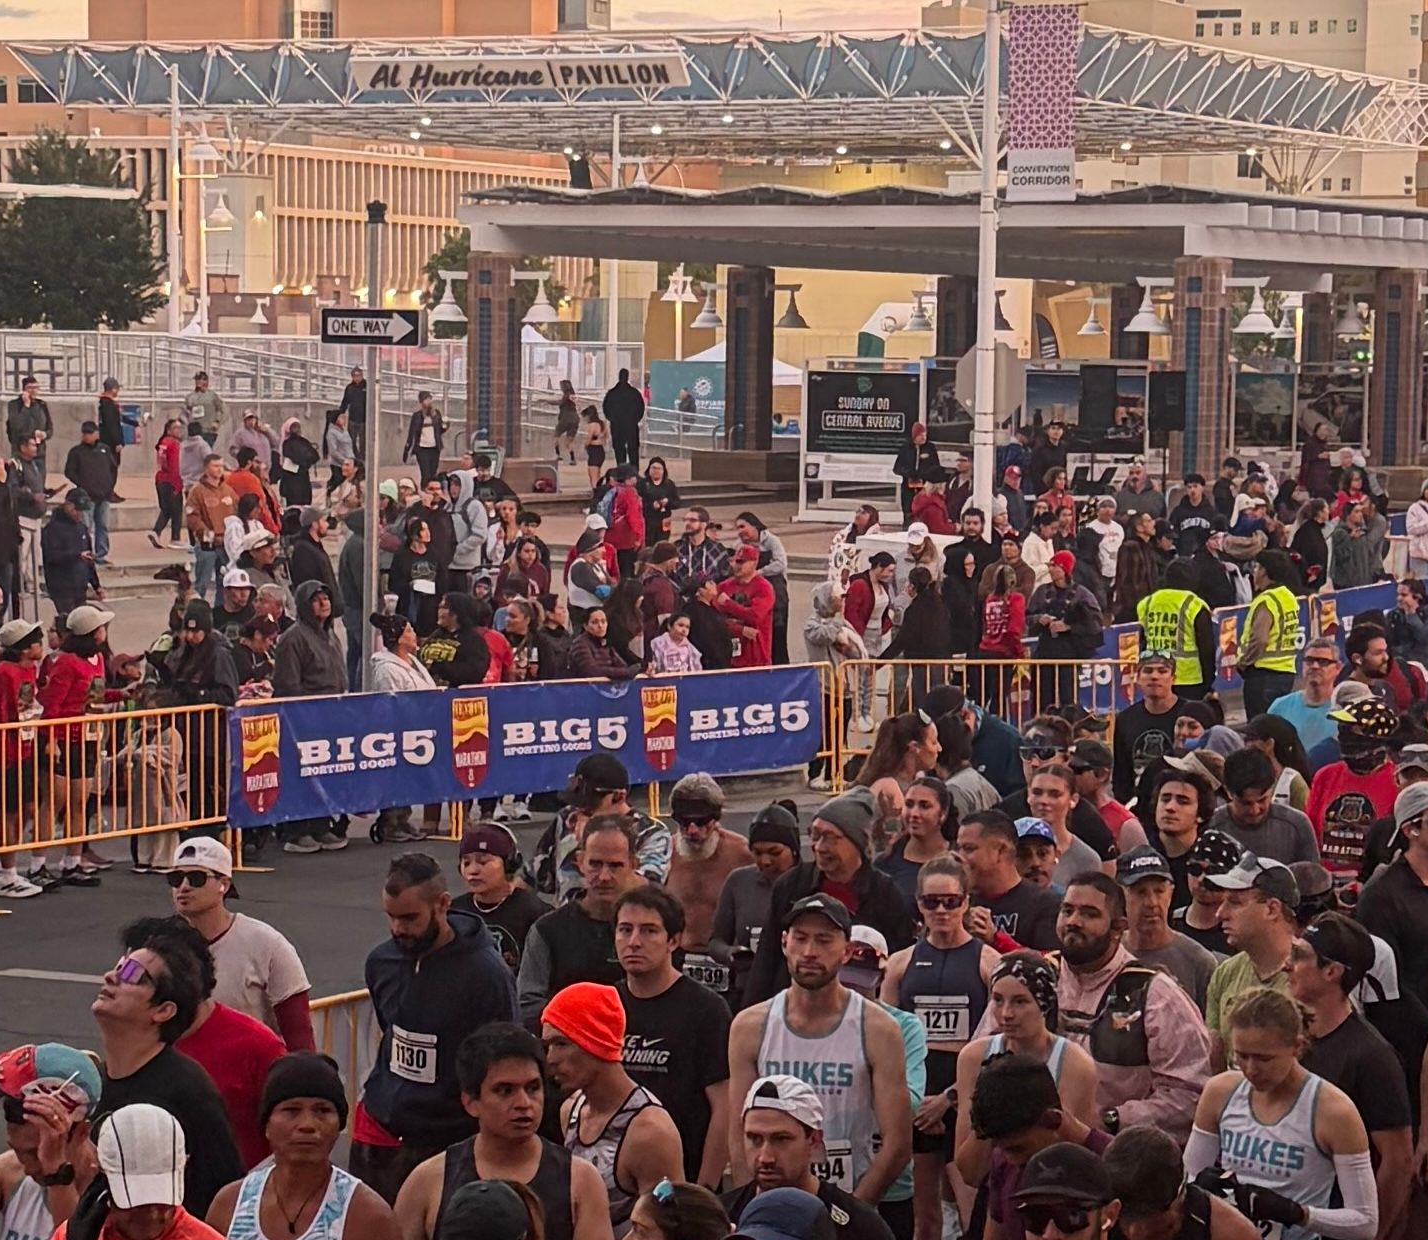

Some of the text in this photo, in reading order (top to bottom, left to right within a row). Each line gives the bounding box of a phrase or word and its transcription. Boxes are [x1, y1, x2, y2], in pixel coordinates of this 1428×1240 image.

[369, 63, 670, 89] Al Hurricane PAVILION
[1012, 165, 1070, 173] CONVENTION
[1012, 176, 1070, 186] CORRIDOR
[332, 319, 390, 334] ONE WAY
[838, 396, 890, 410] SUNDAY ON
[825, 414, 901, 429] CENTRAL AVENUE
[689, 700, 809, 732] BIG 5
[503, 716, 628, 750] BIG 5
[690, 724, 776, 742] SPORTING GOODS
[297, 729, 435, 766] BIG 5
[503, 741, 592, 757] SPORTING GOODS
[300, 757, 397, 777] SPORTING GOODS
[923, 1010, 960, 1030] 1217
[395, 1043, 428, 1069] 1130
[765, 1060, 854, 1088] DUKES
[1221, 1128, 1305, 1171] DUKES
